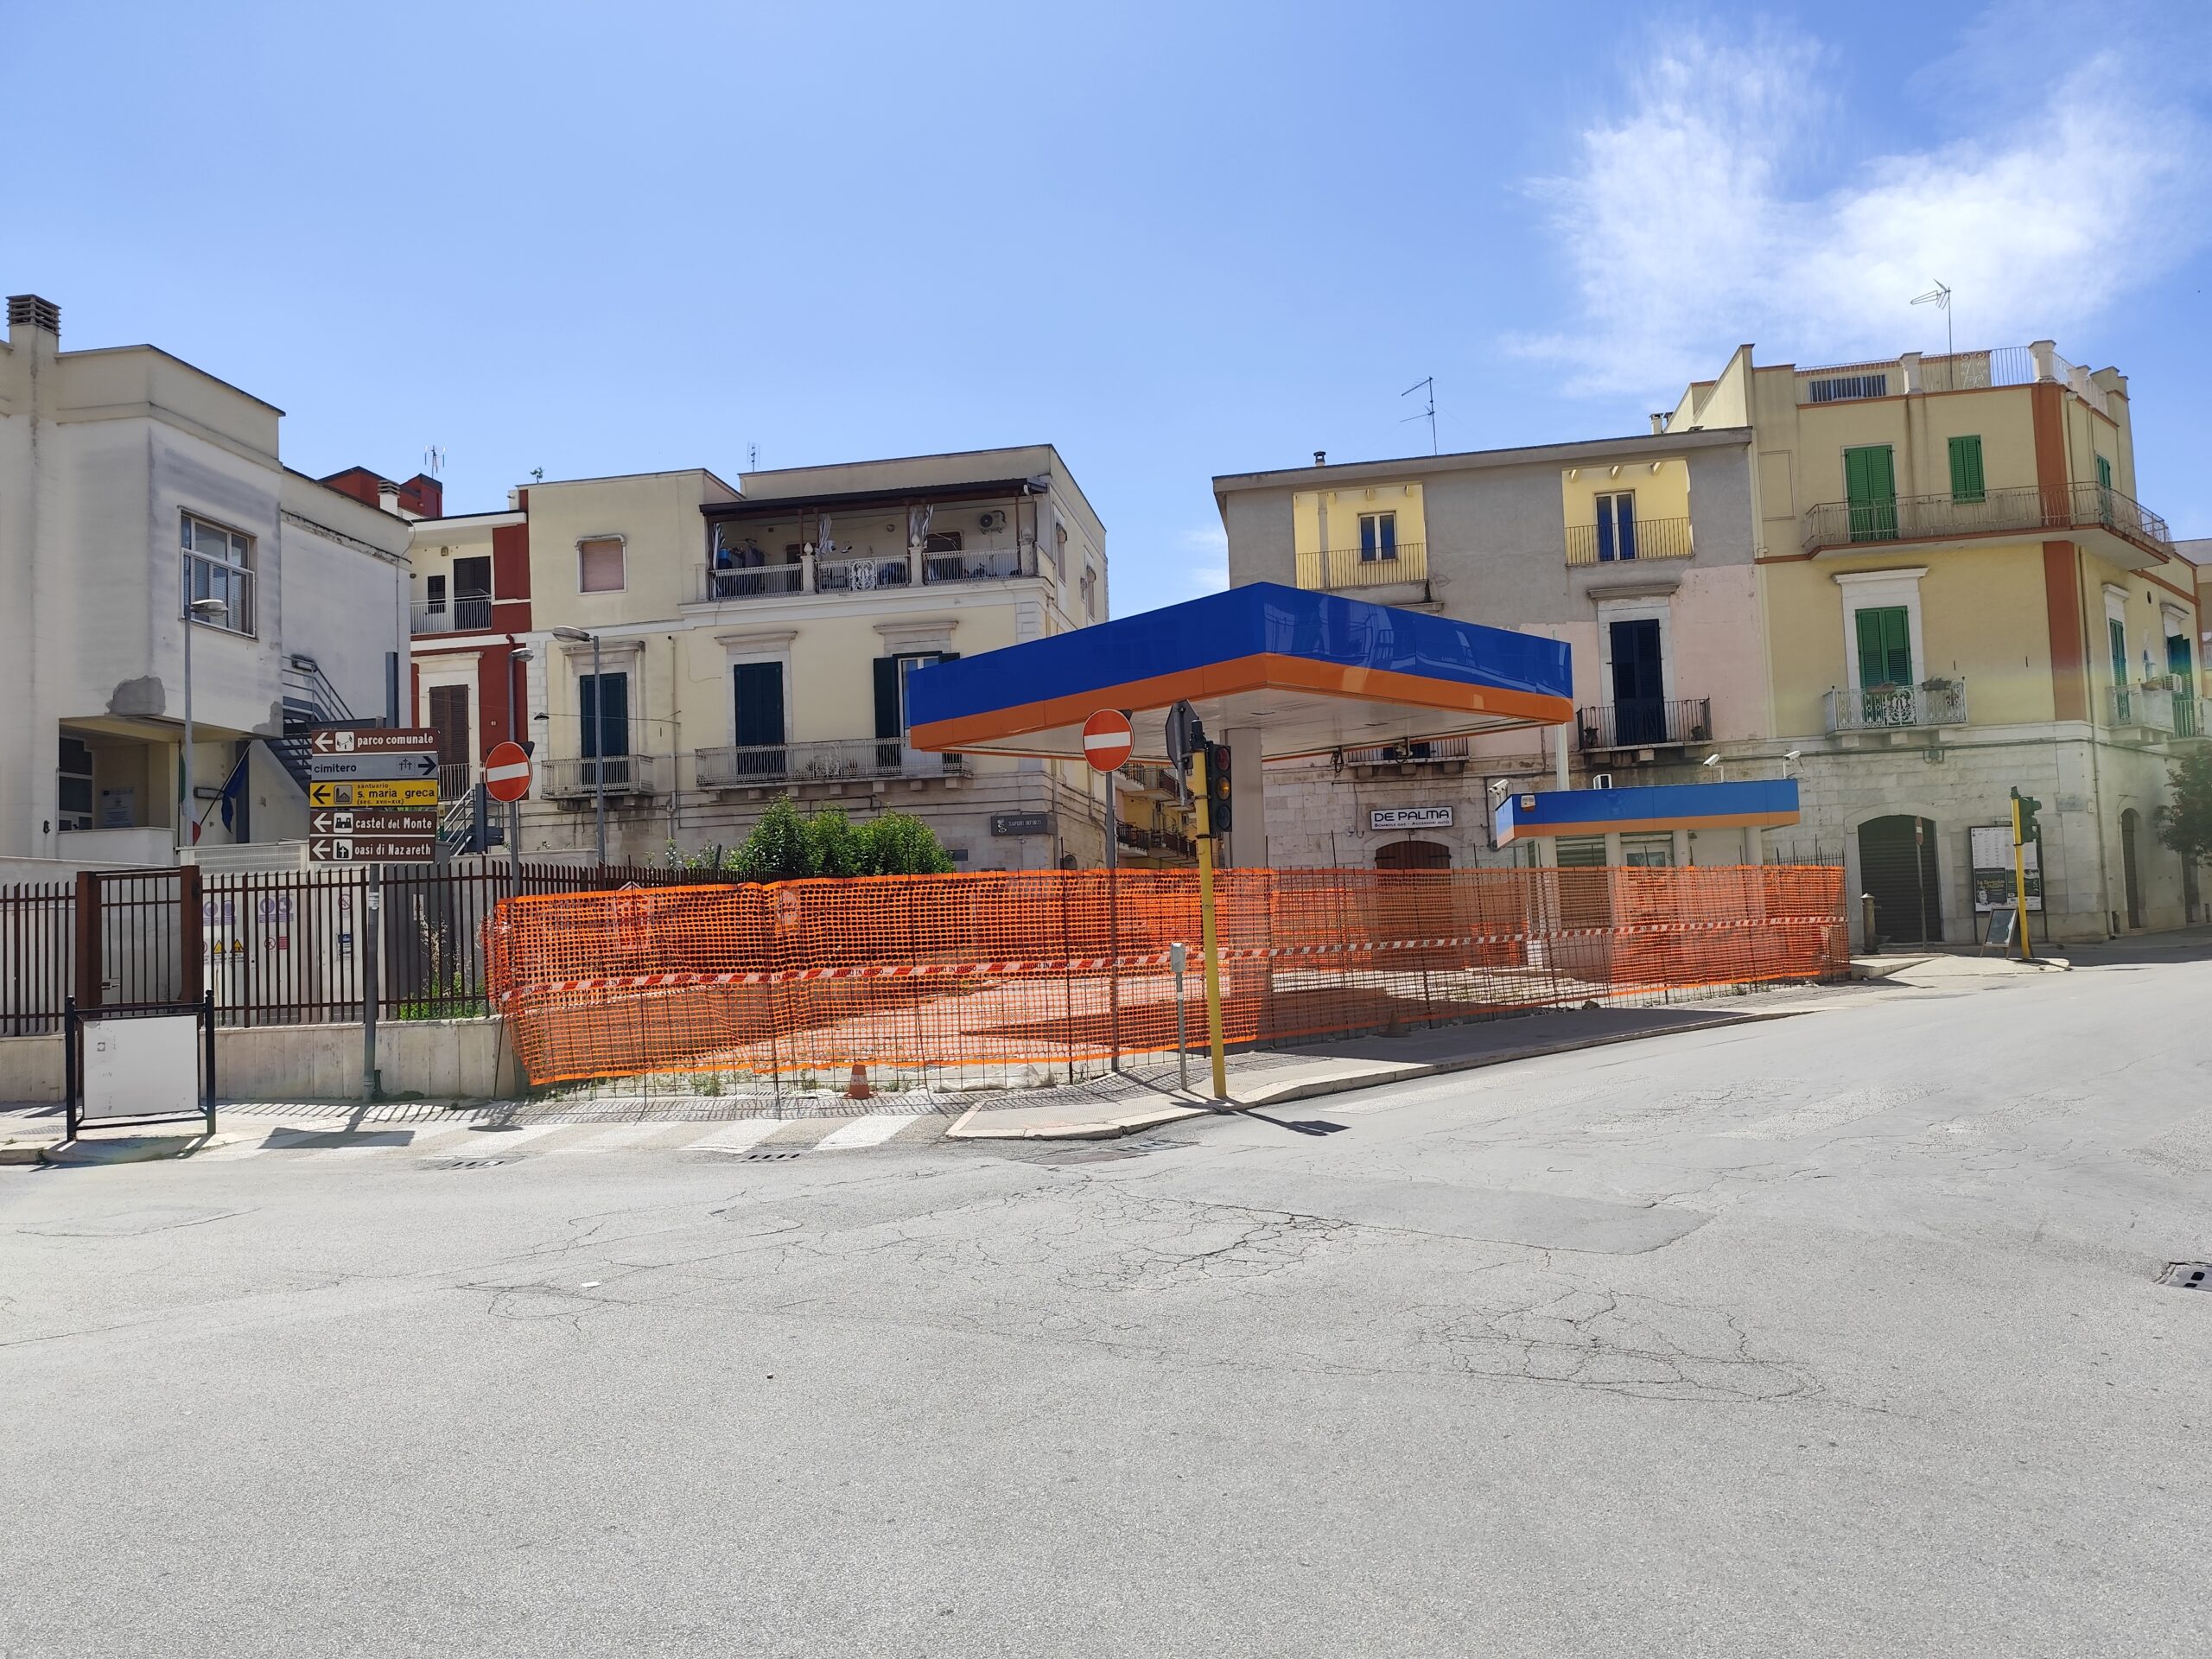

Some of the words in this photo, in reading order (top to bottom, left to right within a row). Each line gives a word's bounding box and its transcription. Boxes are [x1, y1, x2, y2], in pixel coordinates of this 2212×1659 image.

[358, 736, 384, 748] parco
[386, 733, 434, 745] comunale
[314, 764, 356, 773] cimitero
[368, 788, 397, 798] maria
[404, 789, 435, 798] greca
[1374, 812, 1395, 822] DE
[1398, 810, 1449, 820] PALMA
[356, 817, 385, 830] castel
[388, 819, 400, 829] del
[404, 817, 432, 829] Monte
[354, 843, 373, 855] oasi
[376, 843, 385, 855] di
[388, 842, 430, 855] Nazareth
